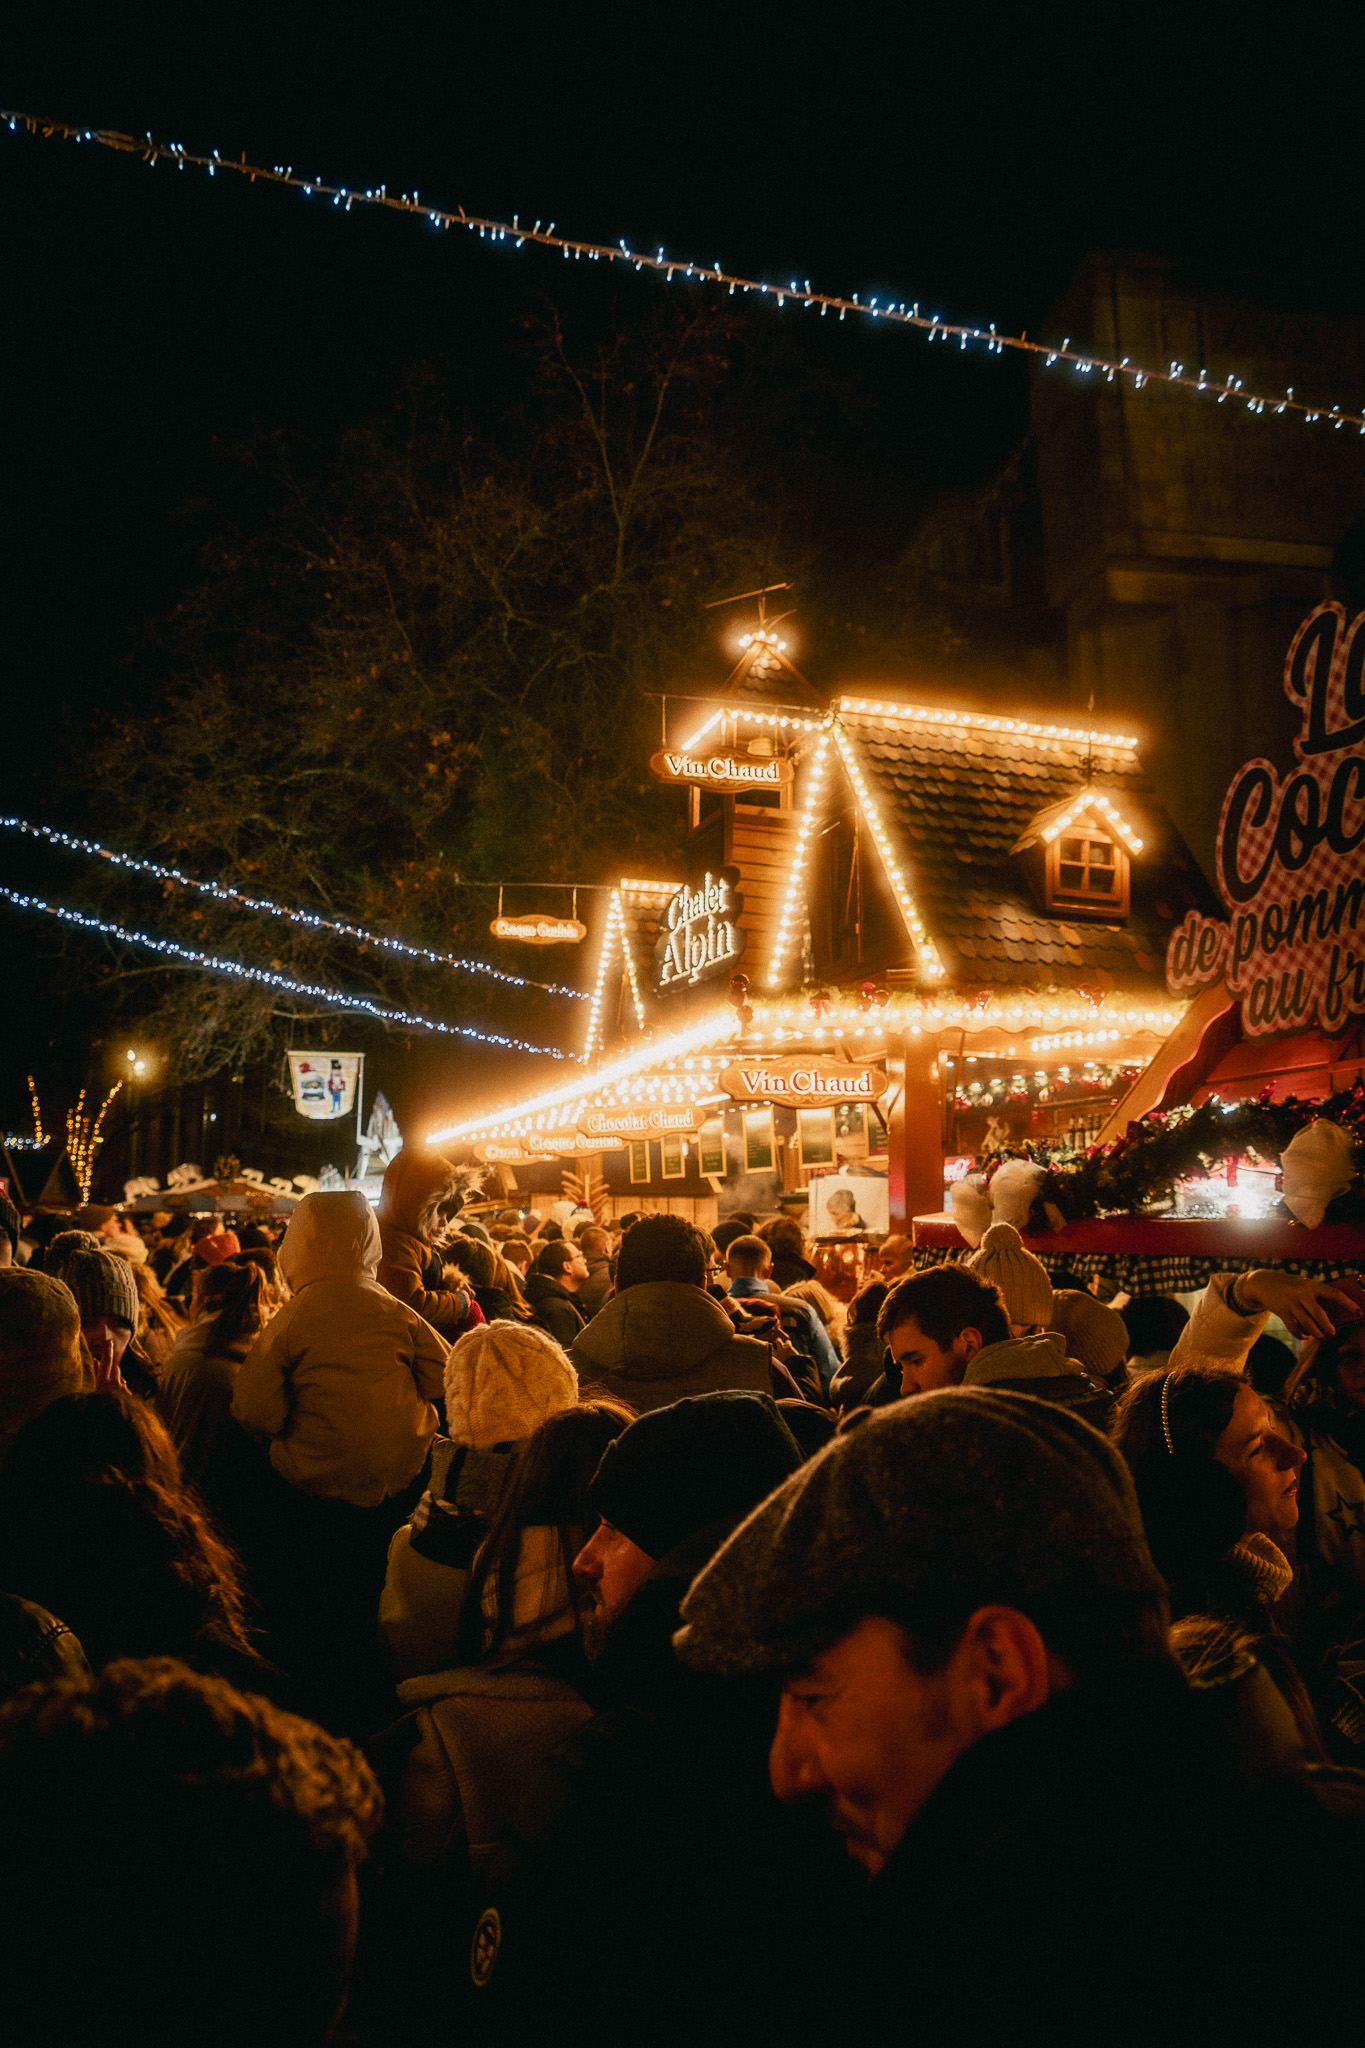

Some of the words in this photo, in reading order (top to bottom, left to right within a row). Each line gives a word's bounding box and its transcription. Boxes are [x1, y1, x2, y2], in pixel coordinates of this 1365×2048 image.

[663, 753, 708, 778] Vin
[707, 757, 781, 783] Chaud
[667, 871, 729, 932] Chalet
[658, 914, 736, 986] Alpin
[1173, 919, 1223, 980] de
[1250, 968, 1314, 1027] au
[740, 1069, 790, 1094] Vin
[789, 1069, 874, 1096] Chaud
[587, 1112, 648, 1133] Chocolat
[649, 1108, 694, 1129] Chaud
